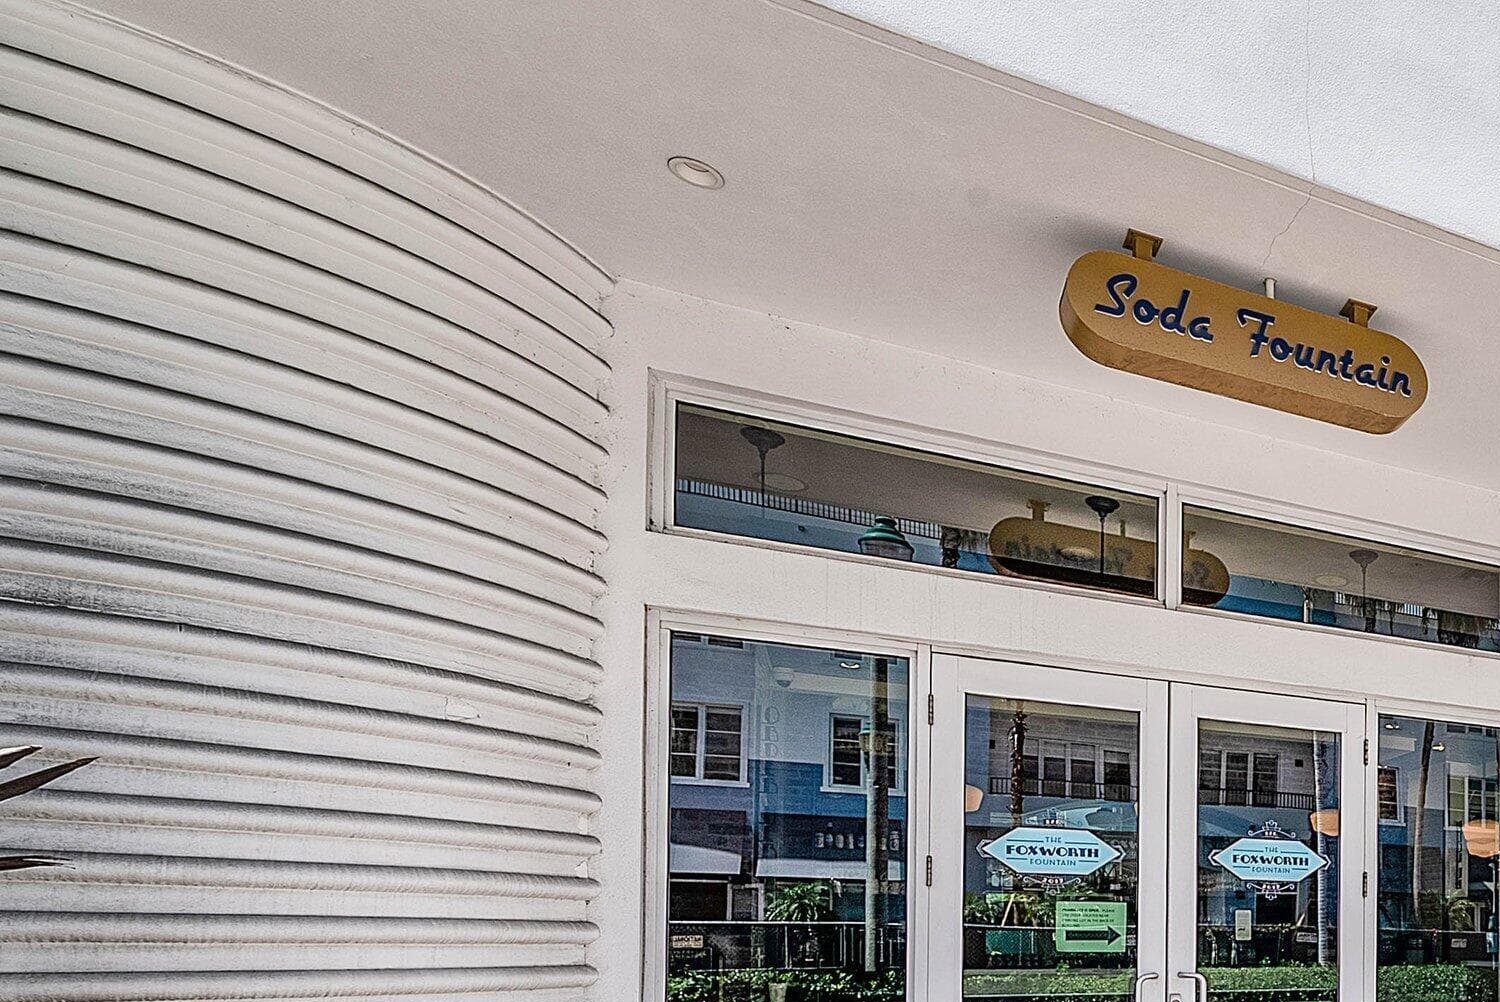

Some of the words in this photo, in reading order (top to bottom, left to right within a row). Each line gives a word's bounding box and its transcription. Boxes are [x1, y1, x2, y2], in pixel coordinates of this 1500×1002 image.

[1094, 273, 1214, 344] Soda
[1235, 308, 1412, 398] Fountain
[1006, 845, 1099, 858] FOXWORTH
[1029, 858, 1077, 866] FOUNTAIN
[1232, 854, 1309, 866] FOXWORTH
